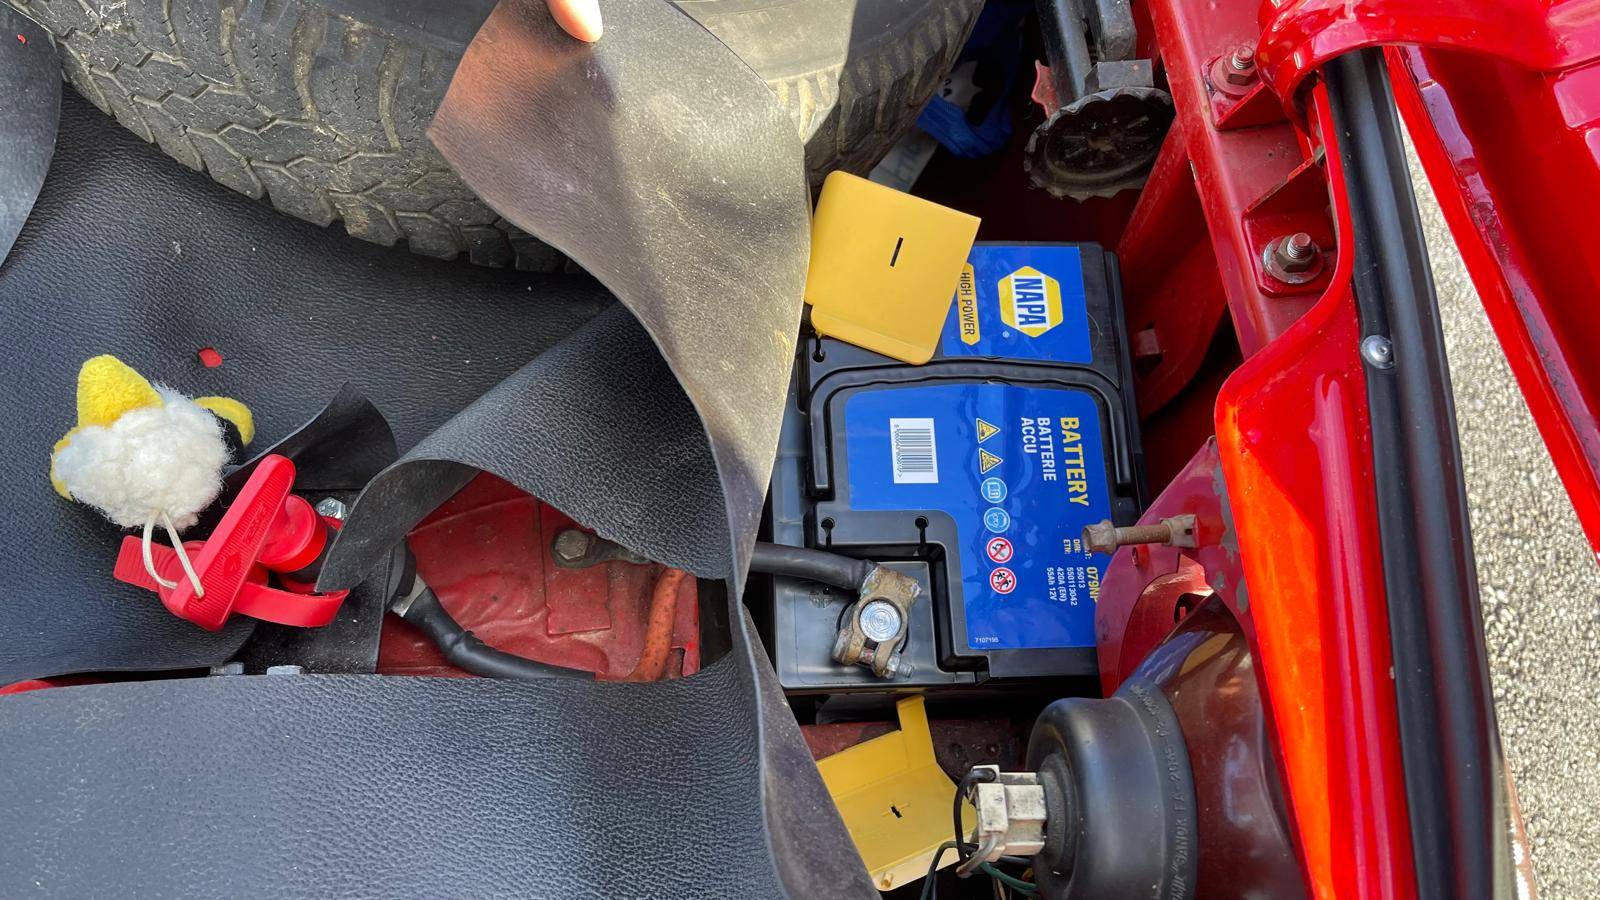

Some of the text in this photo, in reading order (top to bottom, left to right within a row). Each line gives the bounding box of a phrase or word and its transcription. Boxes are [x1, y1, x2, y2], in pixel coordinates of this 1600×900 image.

[960, 272, 976, 335] HIGH POWER
[1014, 278, 1047, 326] NAPA
[1021, 417, 1038, 453] ACCU
[1037, 417, 1057, 481] BATTERIE
[1060, 417, 1089, 506] BATTERY
[1046, 567, 1057, 600] 55Ah 12V
[1056, 567, 1067, 602] 420A (EN)
[1066, 567, 1078, 606] 550113042
[1076, 567, 1086, 588] 55013
